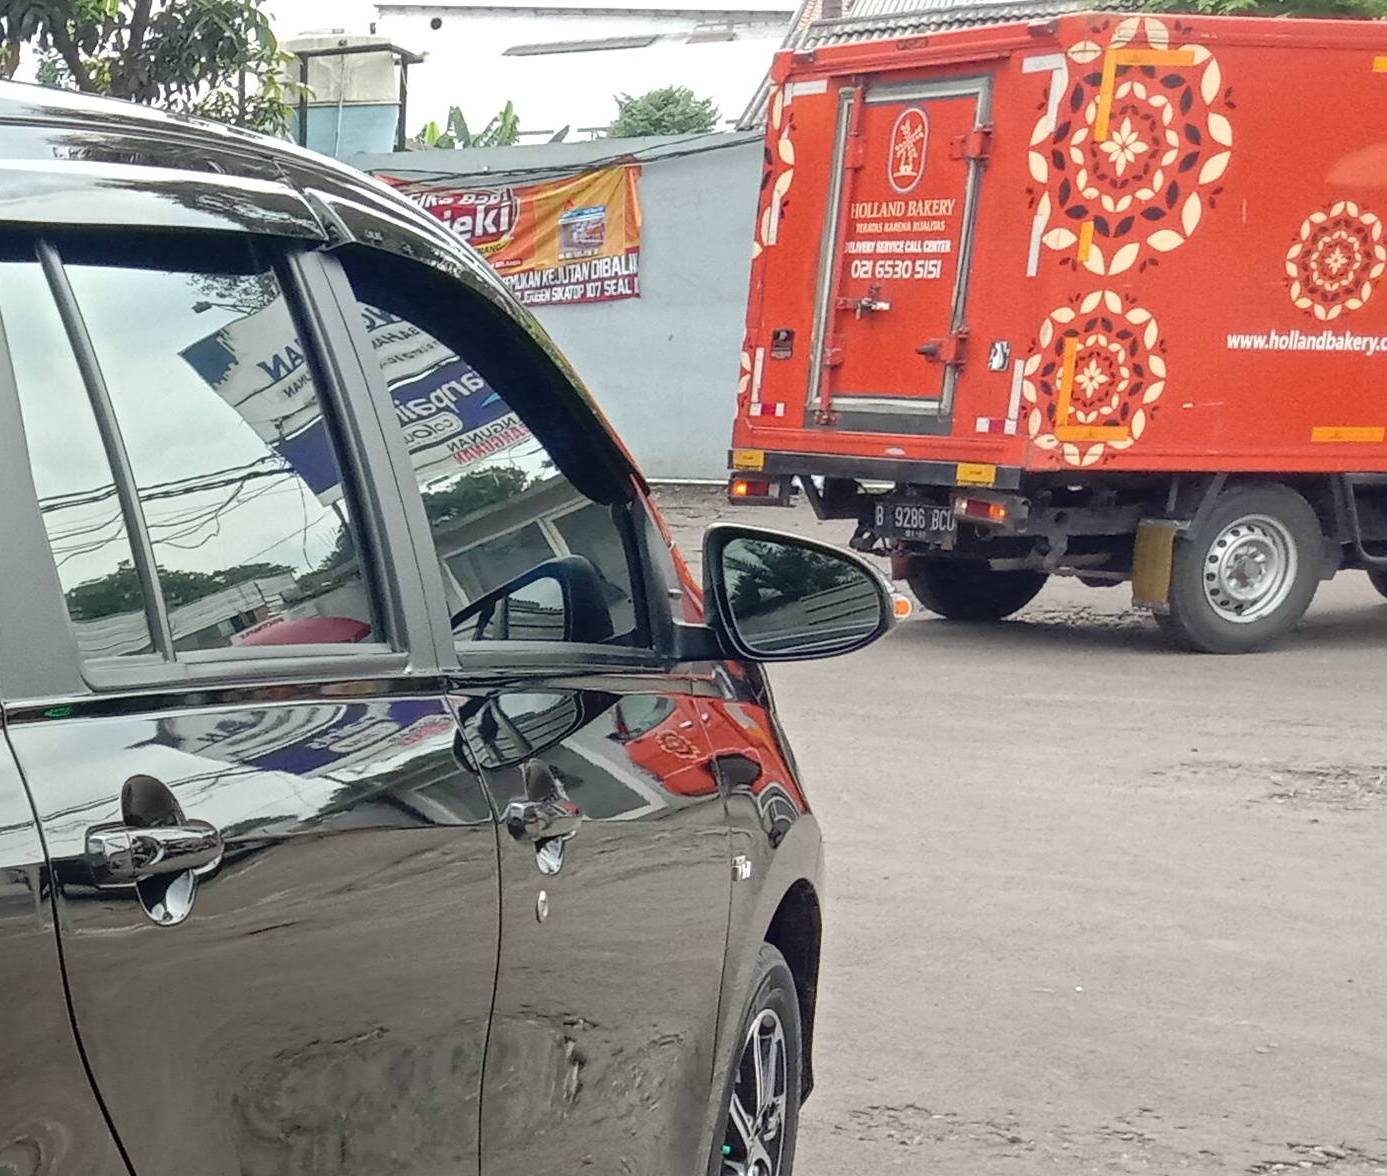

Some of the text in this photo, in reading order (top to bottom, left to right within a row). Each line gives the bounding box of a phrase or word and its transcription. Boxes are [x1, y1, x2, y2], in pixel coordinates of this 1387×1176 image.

[851, 198, 956, 219] HOLLAND BAKERY
[905, 239, 922, 254] CALL
[542, 261, 590, 286] KEJUTAN
[851, 259, 943, 280] 021 6530 5151
[875, 504, 885, 527] B
[894, 506, 926, 529] 9286
